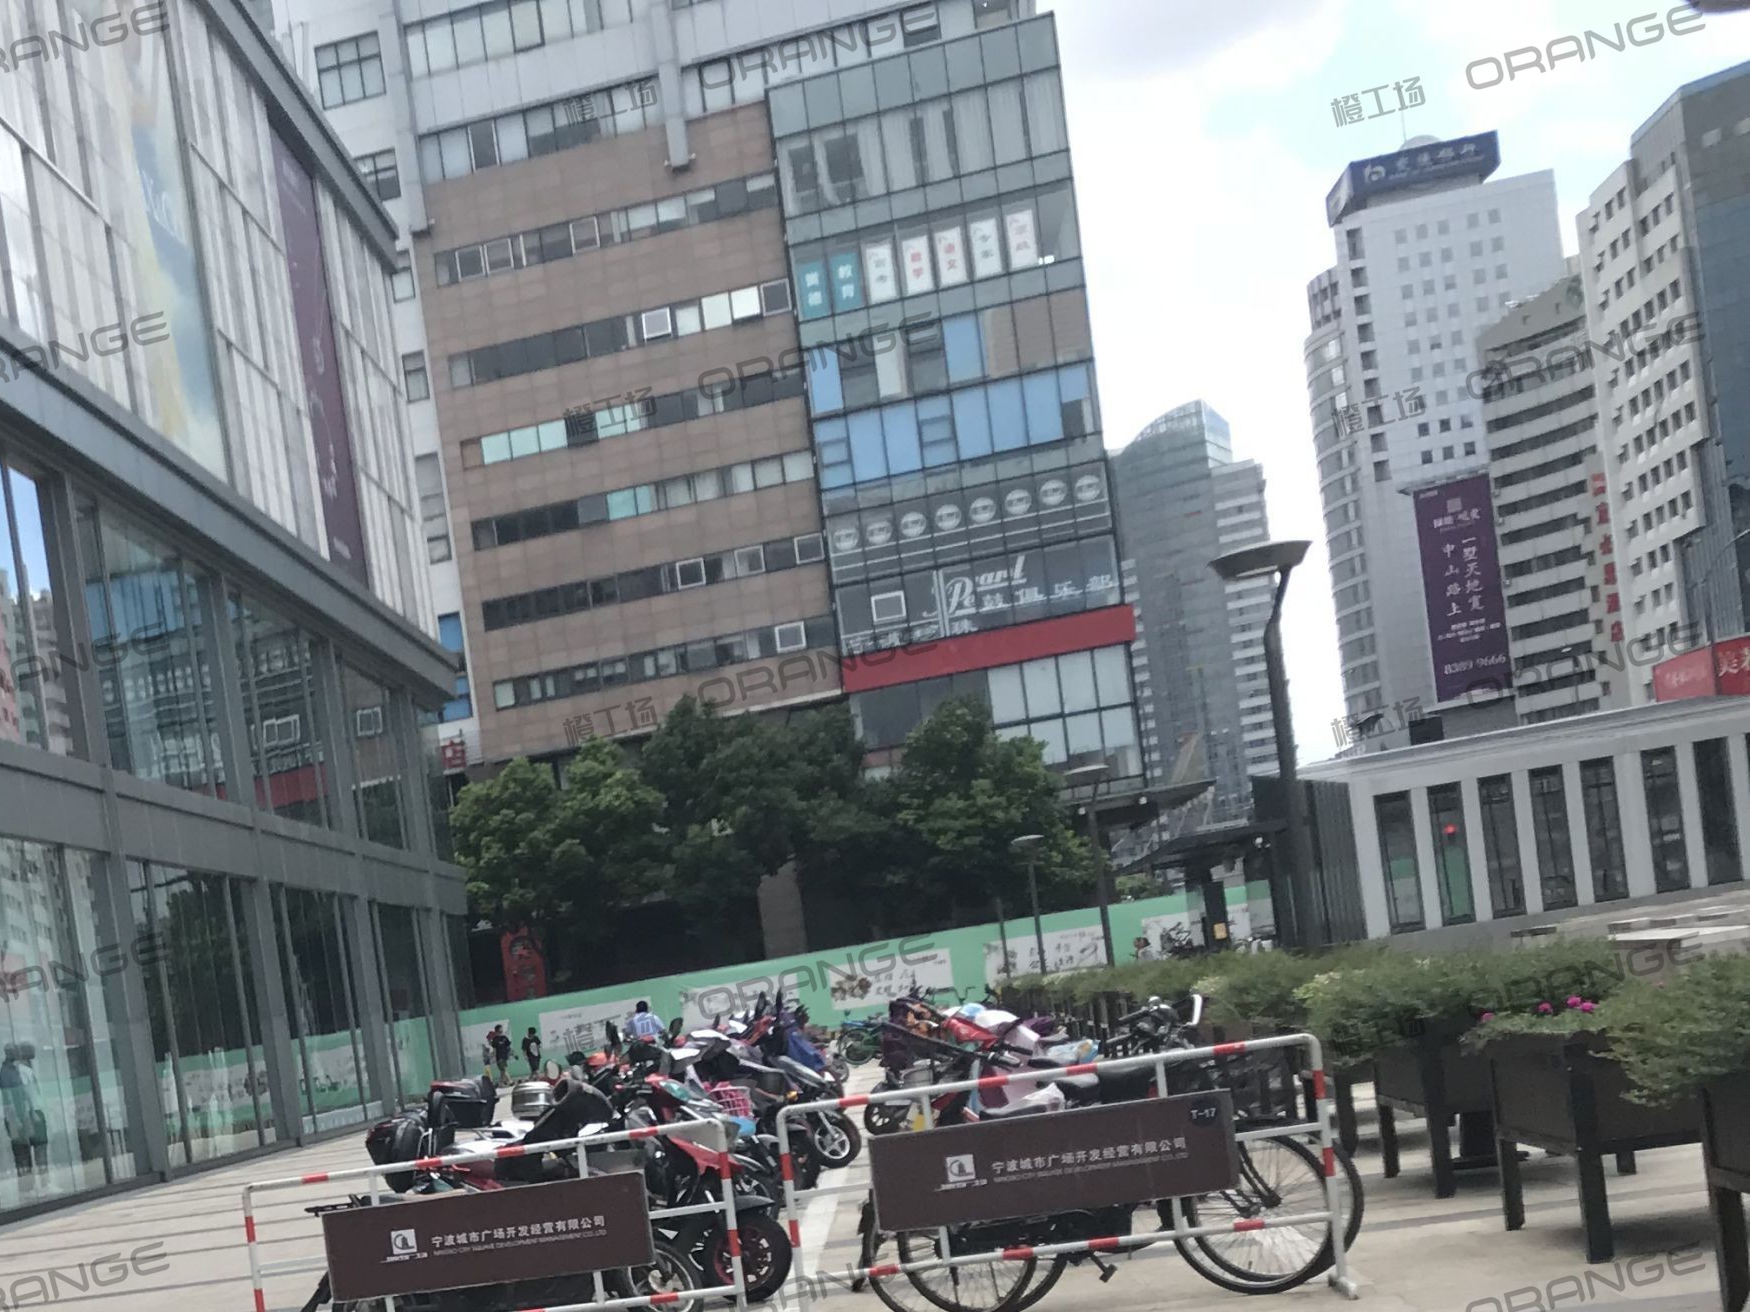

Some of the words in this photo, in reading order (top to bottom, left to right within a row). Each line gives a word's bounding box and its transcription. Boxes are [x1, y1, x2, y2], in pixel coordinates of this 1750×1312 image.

[1190, 1107, 1217, 1120] T-17
[992, 1136, 1186, 1175] 宁波城市广场开发经营有限公司
[431, 1215, 606, 1248] 宁波城市广场开发经营有限公司
